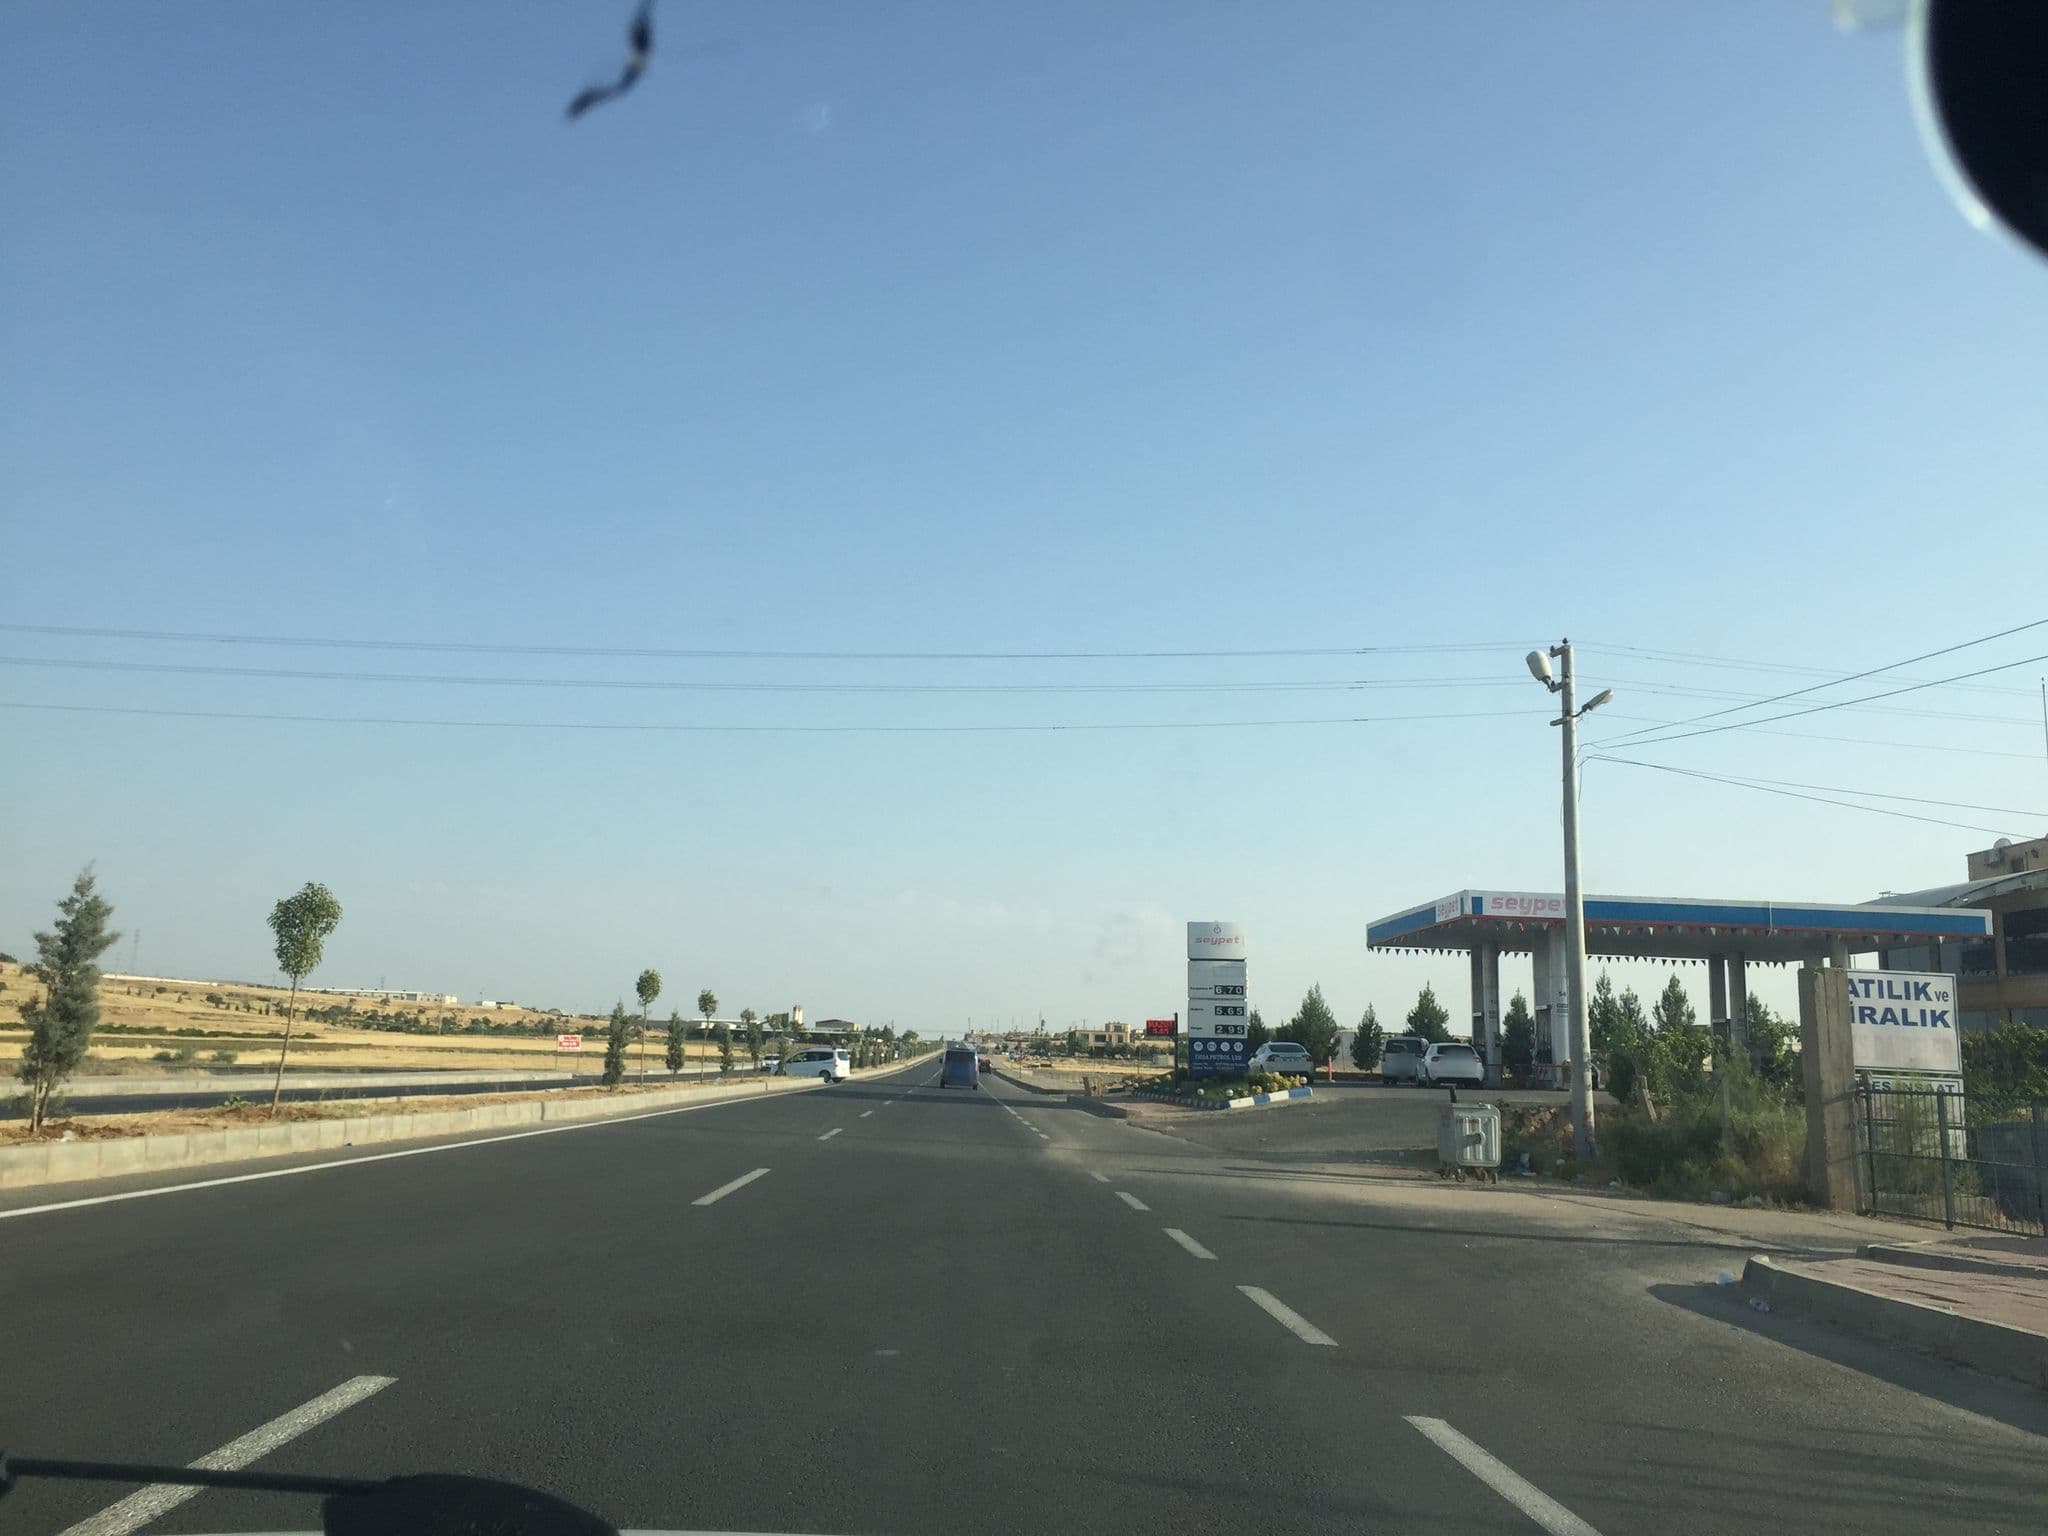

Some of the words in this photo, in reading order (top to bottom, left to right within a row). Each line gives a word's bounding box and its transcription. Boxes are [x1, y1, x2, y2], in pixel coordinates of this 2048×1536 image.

[1490, 895, 1566, 916] seype
[1195, 936, 1241, 946] seypet
[1215, 985, 1244, 995] 6.70
[1848, 978, 1933, 1002] ATILIK
[1934, 990, 1950, 1003] ve
[1215, 1006, 1244, 1016] 5.65
[1849, 1001, 1952, 1028] İRALIK
